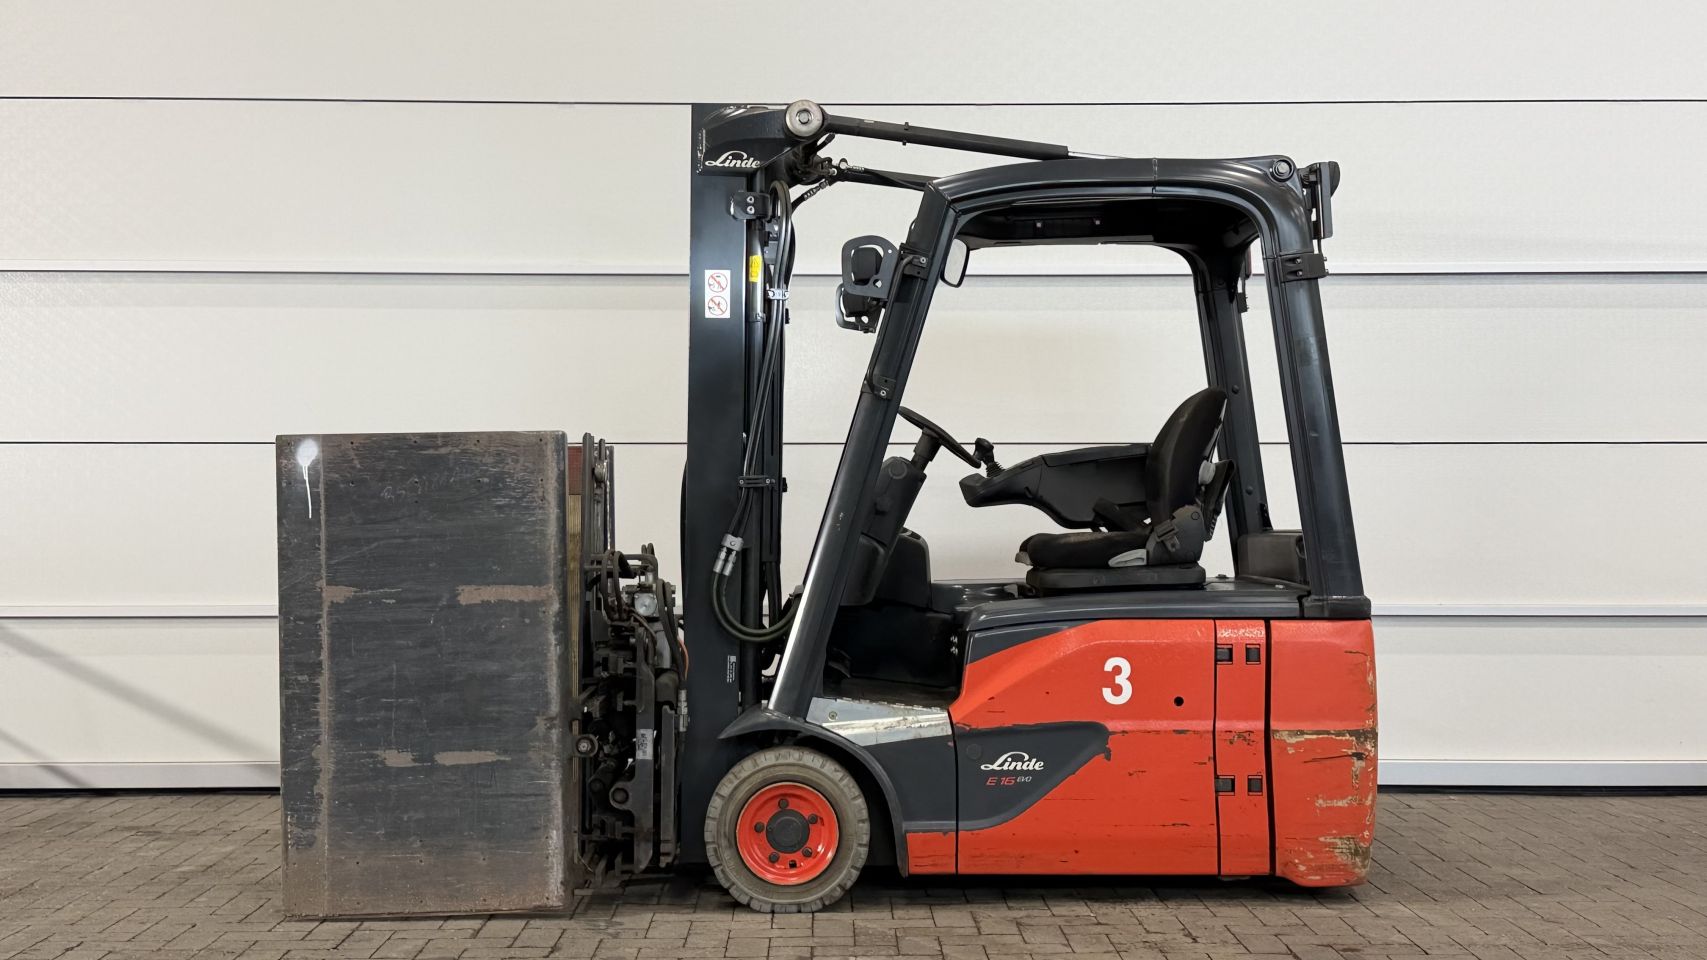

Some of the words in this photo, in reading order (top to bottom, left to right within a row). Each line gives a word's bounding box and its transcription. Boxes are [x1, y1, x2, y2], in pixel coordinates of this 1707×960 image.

[705, 150, 760, 168] Linde
[1102, 656, 1133, 705] 3
[980, 751, 1044, 770] Linde
[986, 776, 998, 785] E
